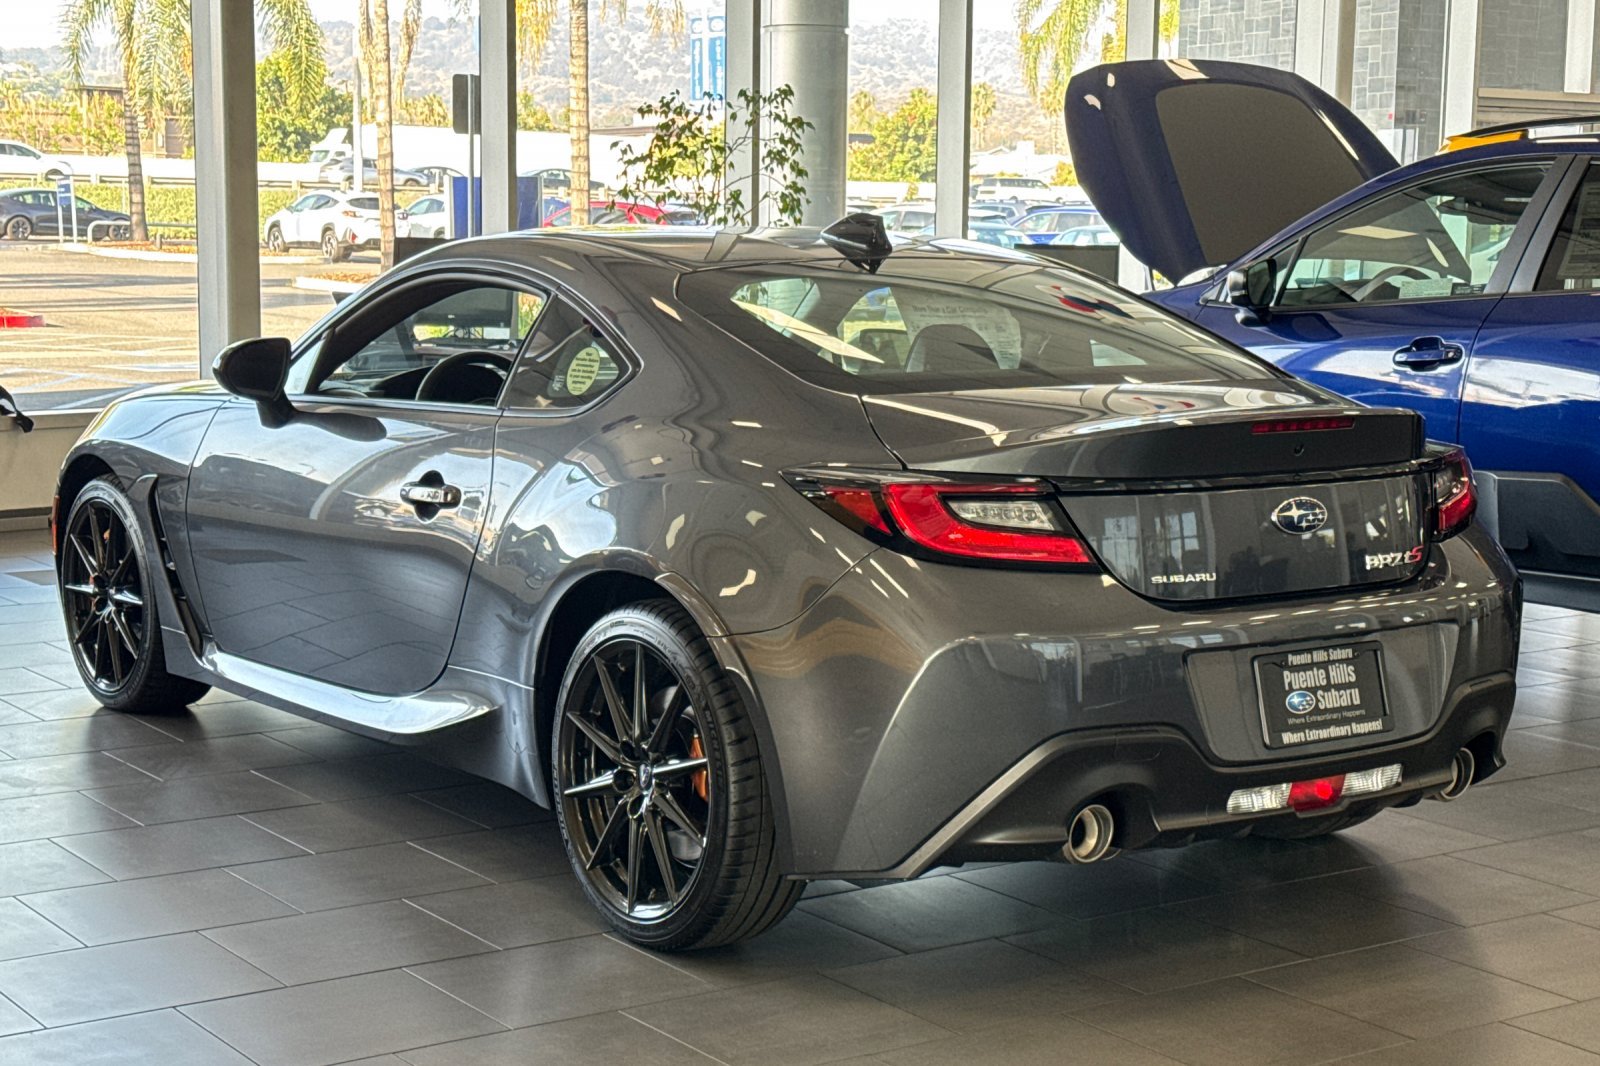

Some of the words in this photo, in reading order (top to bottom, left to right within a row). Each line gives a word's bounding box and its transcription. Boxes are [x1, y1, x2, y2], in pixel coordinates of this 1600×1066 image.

[1365, 552, 1403, 570] BRZ
[1151, 572, 1216, 584] SUBARU
[1288, 652, 1312, 666] Puente
[1313, 650, 1328, 662] Hills
[1329, 648, 1353, 660] Subaru
[1283, 667, 1327, 690] Puente
[1328, 663, 1356, 685] Hills
[1317, 688, 1361, 710] Subaru
[1287, 716, 1306, 725] Where
[1306, 712, 1342, 723] Extraordinary
[1342, 709, 1366, 719] Happens
[1281, 731, 1306, 744] Where
[1306, 725, 1352, 741] Extraordinary
[1352, 718, 1383, 734] Happens!
